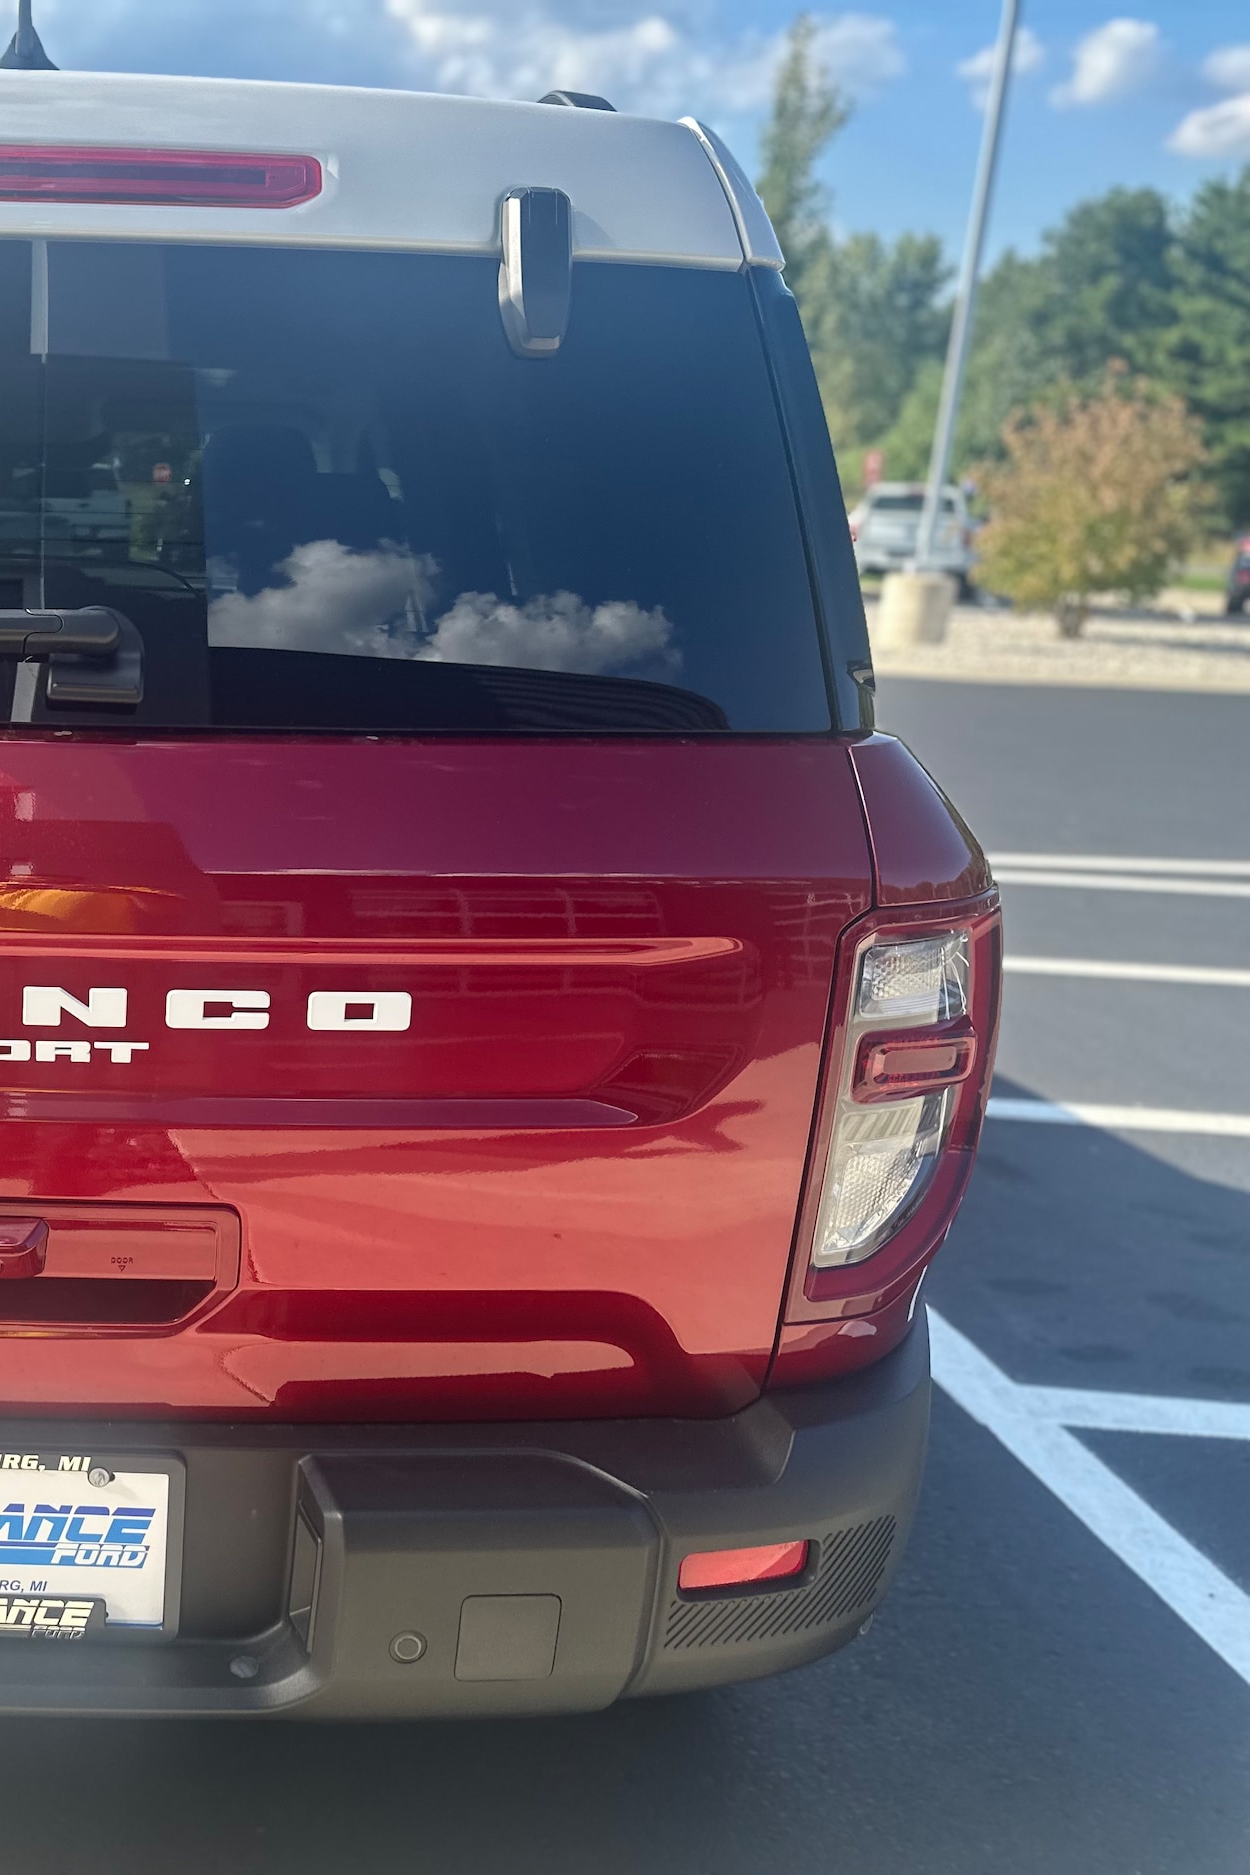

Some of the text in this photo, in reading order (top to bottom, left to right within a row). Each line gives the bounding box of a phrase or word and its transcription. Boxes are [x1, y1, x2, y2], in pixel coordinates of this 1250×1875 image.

[110, 1256, 134, 1264] DOOR
[57, 1455, 92, 1472] MI
[50, 1542, 147, 1568] FORD
[29, 1580, 48, 1592] MI
